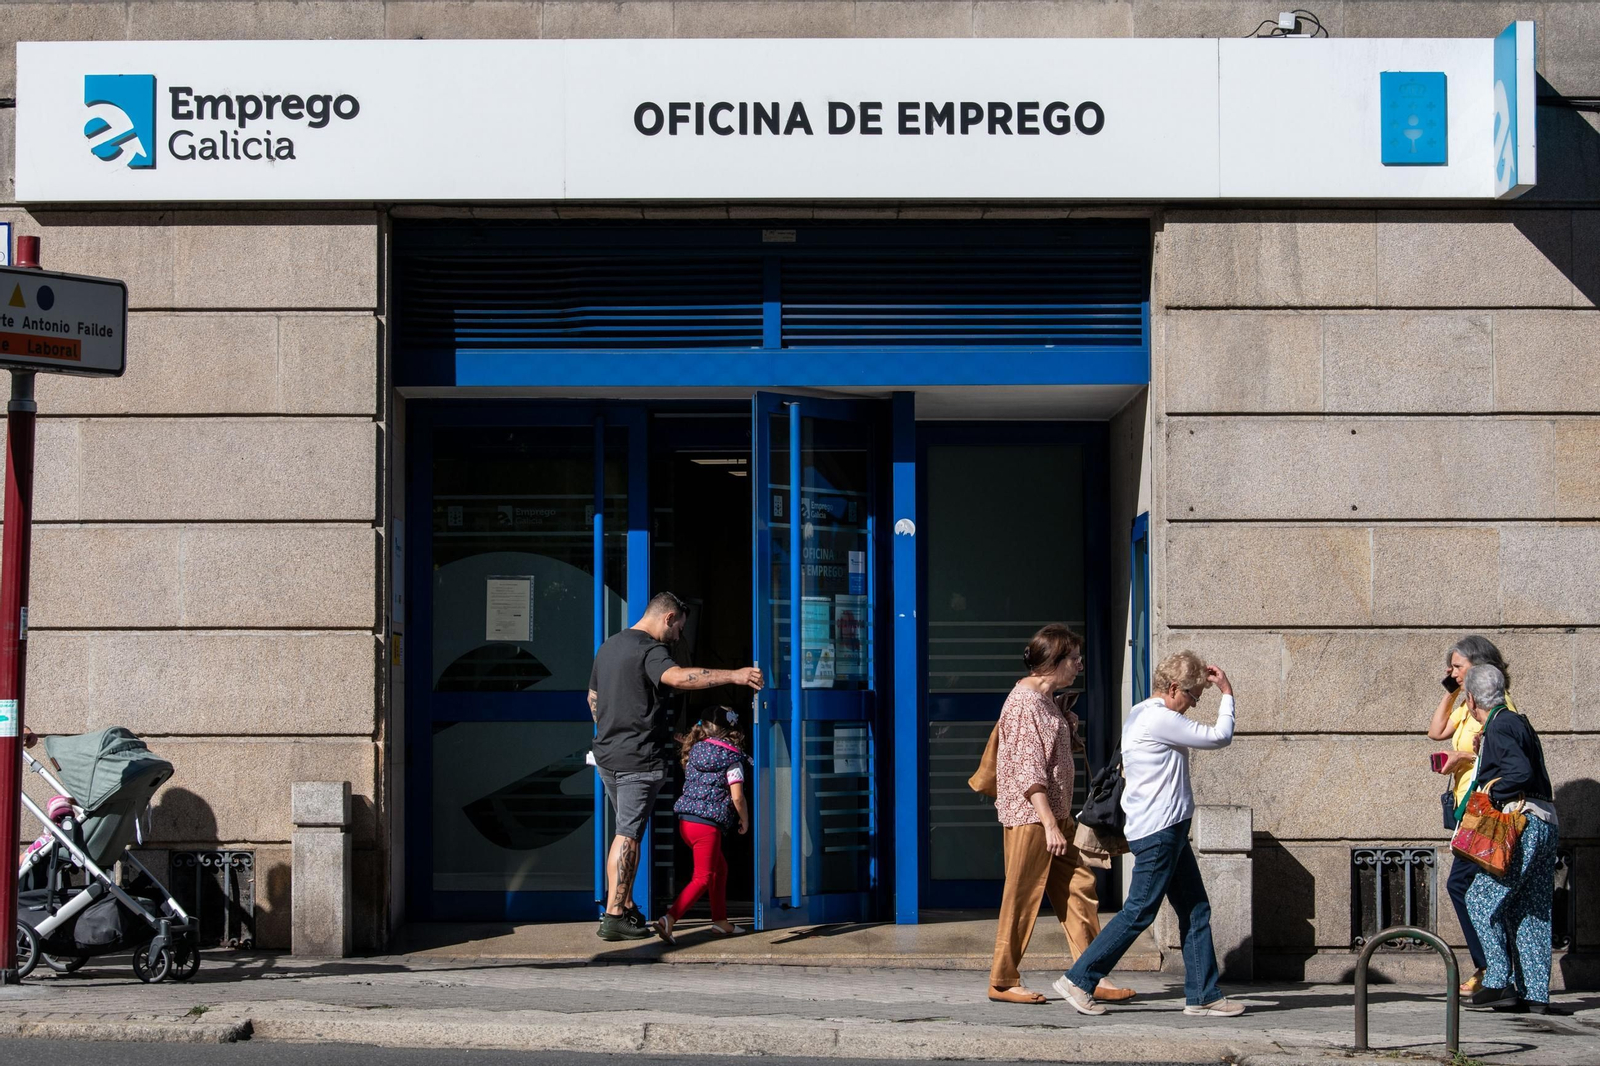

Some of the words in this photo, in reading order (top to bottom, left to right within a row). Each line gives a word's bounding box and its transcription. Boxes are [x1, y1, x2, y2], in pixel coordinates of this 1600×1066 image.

[168, 86, 360, 128] Emprego
[633, 101, 814, 136] OFICINA
[828, 101, 883, 136] DE
[898, 101, 1105, 136] EMPREGO
[168, 129, 296, 160] Galicia
[22, 316, 70, 333] Antonio
[78, 322, 113, 338] Failde
[28, 339, 78, 358] Laboral
[515, 507, 556, 517] Emprego
[811, 501, 834, 512] Emprego
[515, 517, 543, 525] Galicia
[811, 511, 827, 519] Galicia
[803, 547, 834, 560] OFICINA
[807, 565, 843, 578] EMPREGO
